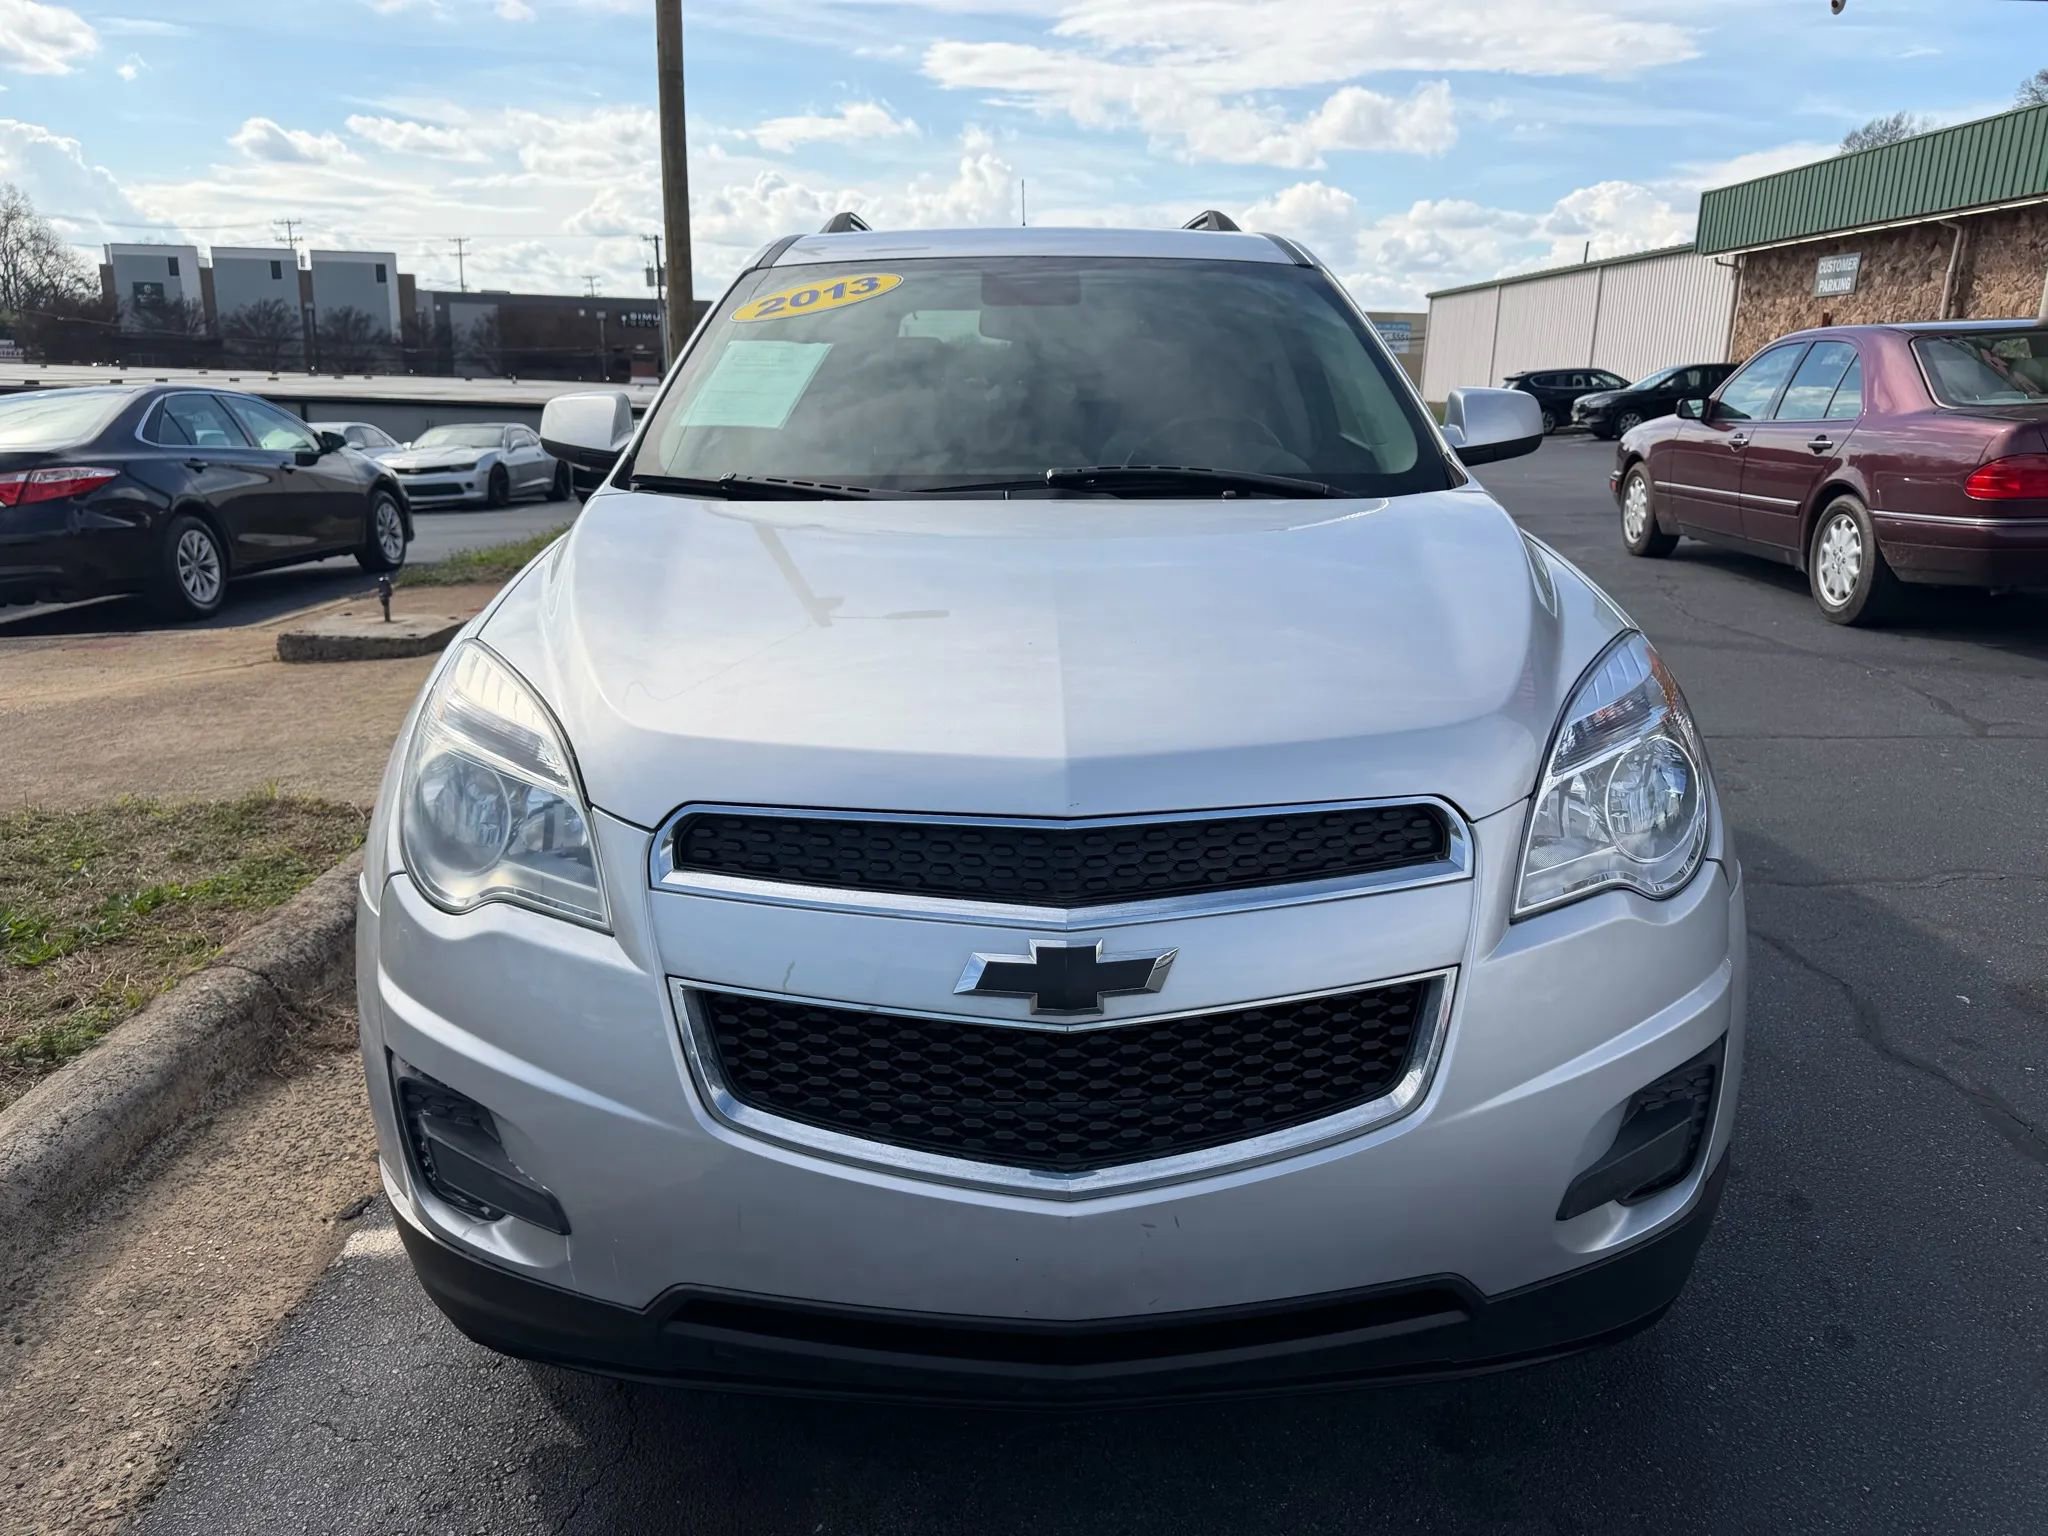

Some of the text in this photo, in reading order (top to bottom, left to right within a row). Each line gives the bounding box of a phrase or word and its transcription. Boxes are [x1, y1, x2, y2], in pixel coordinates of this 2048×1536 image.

[1818, 257, 1859, 273] CUSTOMER
[1818, 277, 1851, 292] PARKING
[754, 276, 881, 318] 2013
